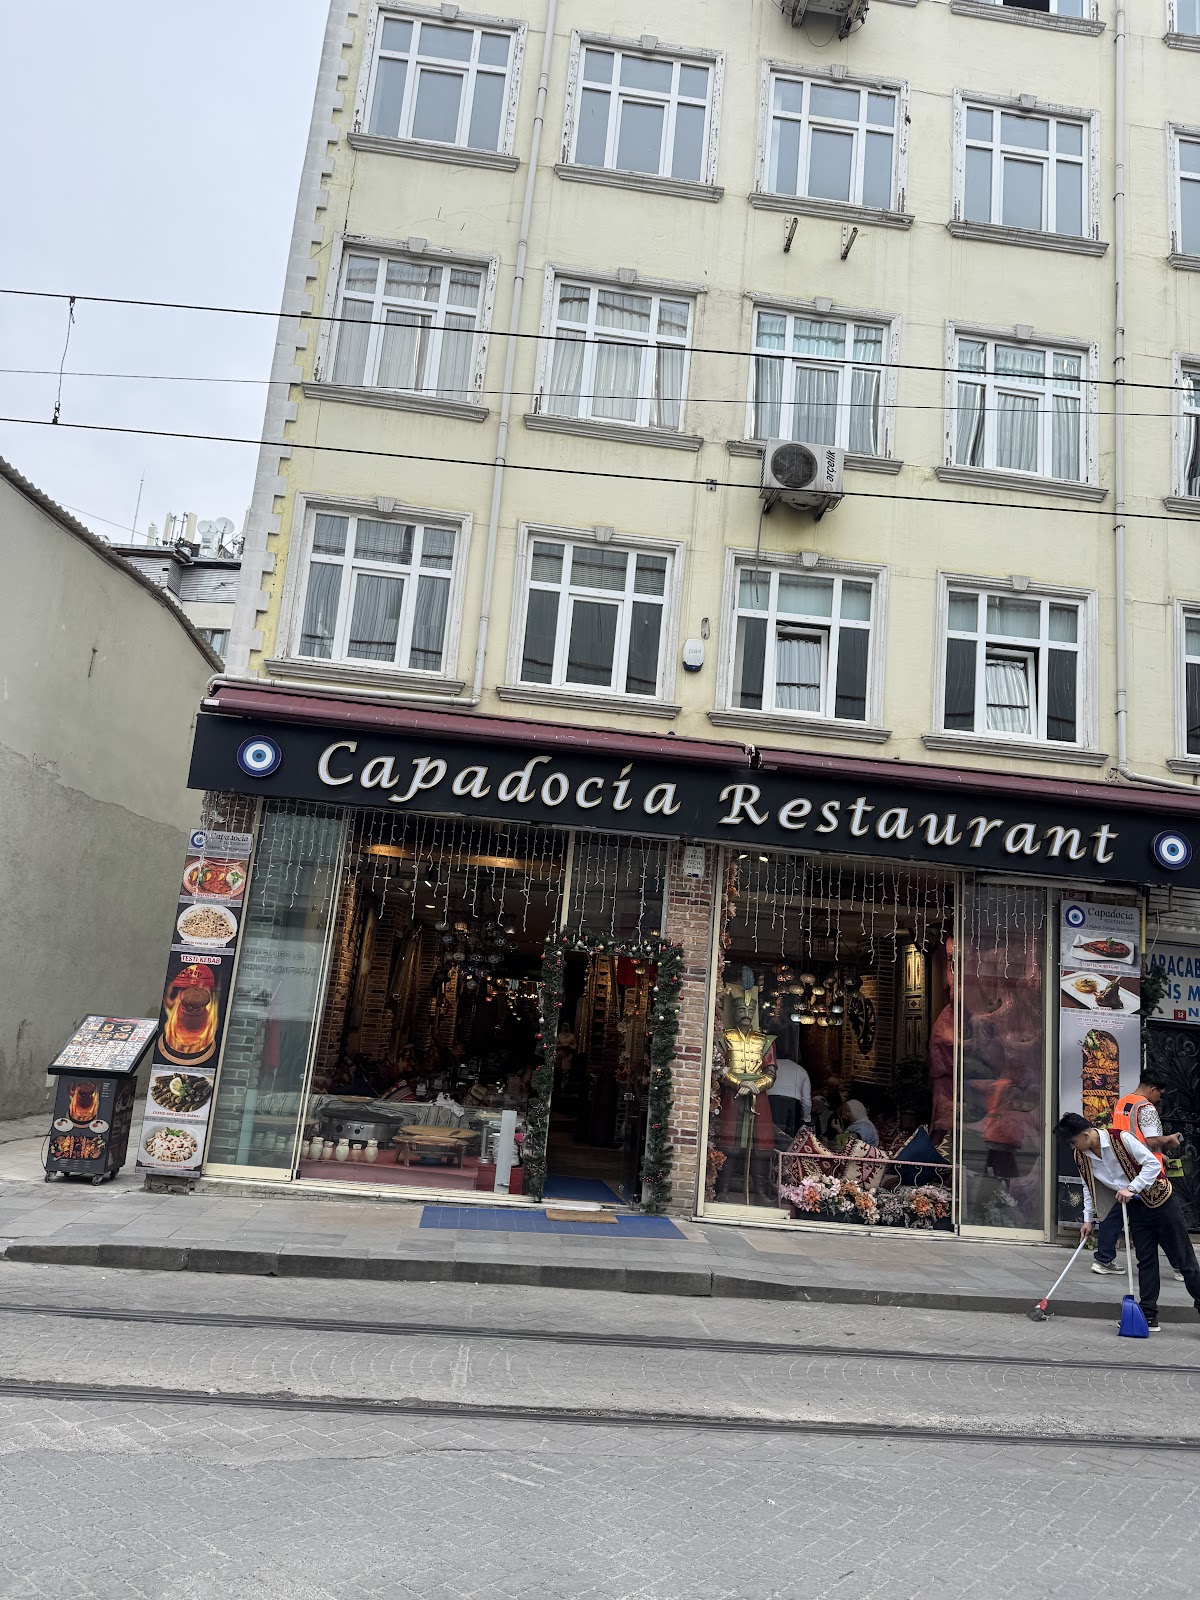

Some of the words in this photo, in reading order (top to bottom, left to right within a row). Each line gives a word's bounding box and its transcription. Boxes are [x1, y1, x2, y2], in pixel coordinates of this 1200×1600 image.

[826, 449, 836, 482] arçelik
[718, 783, 1119, 864] Restaurant
[1088, 907, 1134, 920] Capadocia
[199, 956, 221, 964] KEBAB
